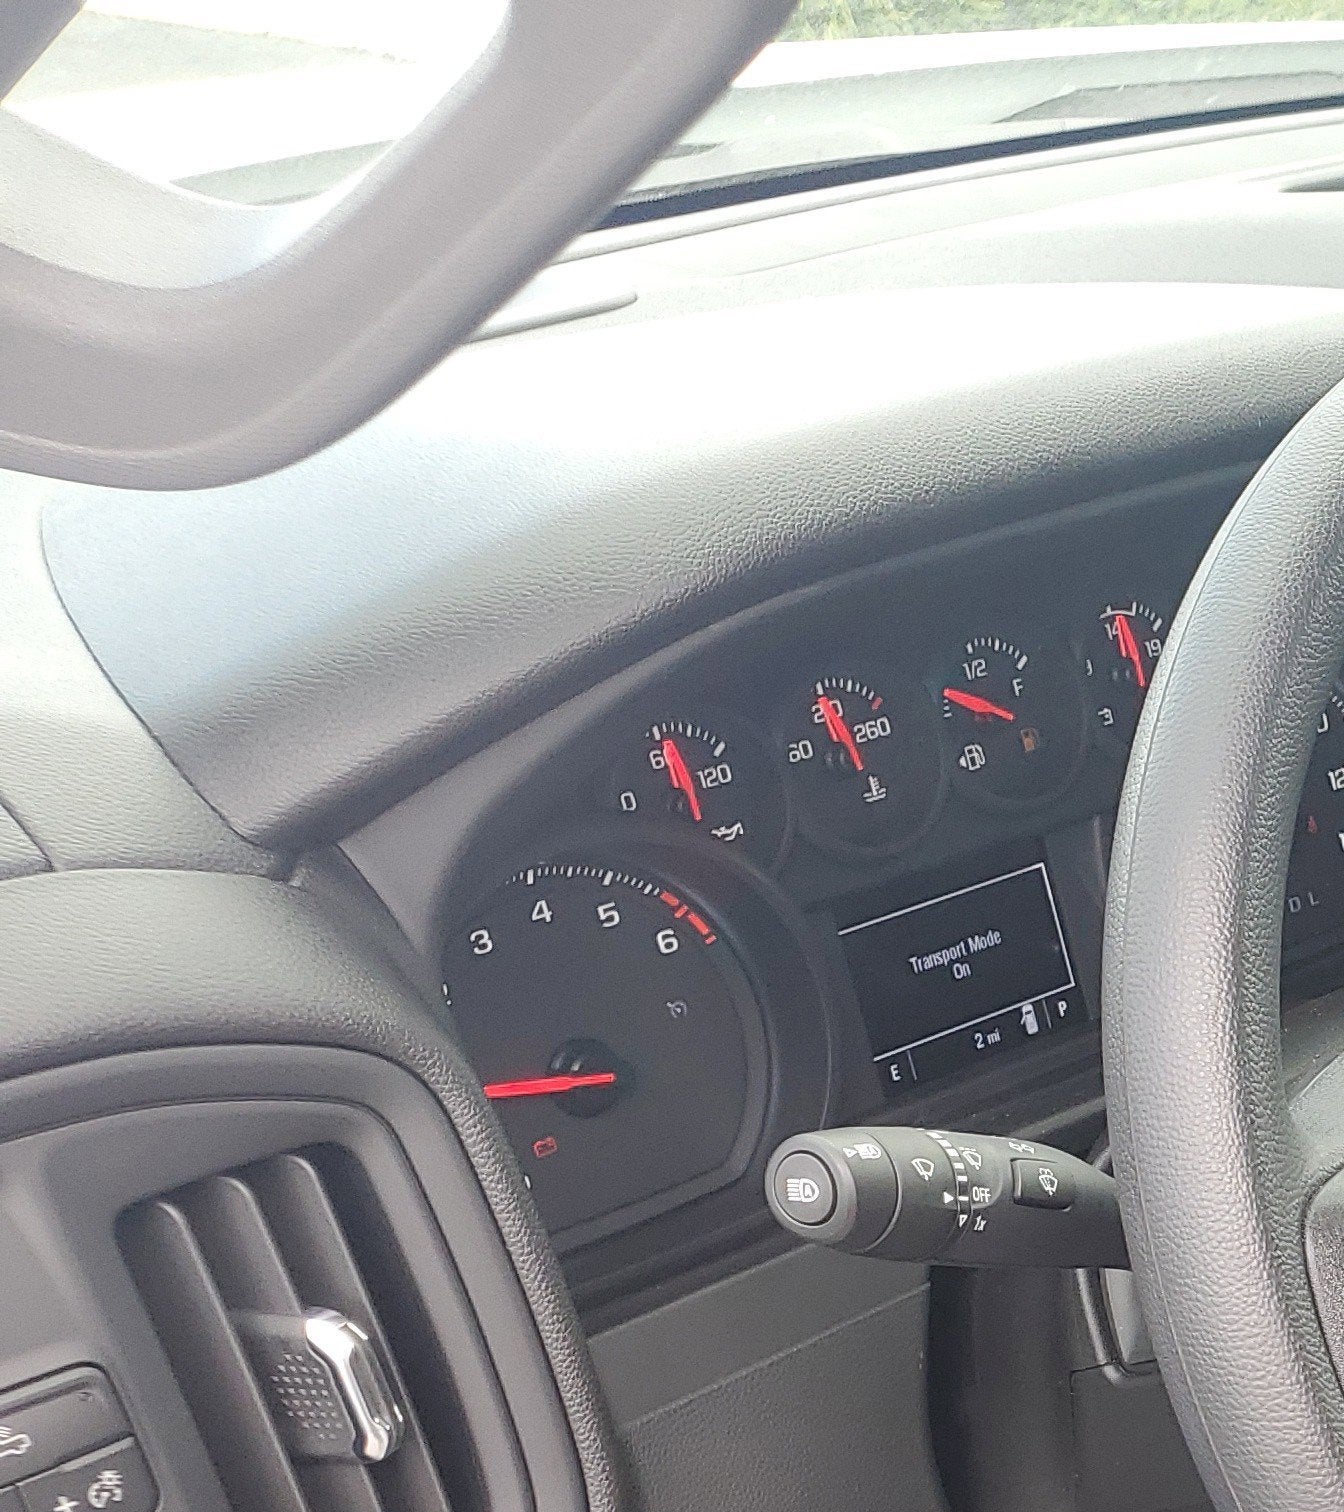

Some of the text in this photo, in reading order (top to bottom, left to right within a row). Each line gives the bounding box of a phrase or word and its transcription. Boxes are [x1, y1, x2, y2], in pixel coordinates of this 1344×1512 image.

[1144, 638, 1161, 658] 19
[962, 658, 988, 680] 1/2
[1012, 678, 1024, 697] F
[854, 716, 891, 743] 260
[696, 763, 732, 789] 120
[620, 791, 637, 811] 0
[531, 899, 553, 924] 4
[597, 901, 621, 928] 5
[469, 928, 493, 955] 3
[656, 928, 679, 954] 6
[908, 929, 1002, 975] Transport Mode
[953, 962, 972, 980] On
[1057, 1000, 1068, 1018] P
[974, 1028, 1001, 1050] 2 mi
[890, 1064, 902, 1082] E
[972, 1186, 992, 1203] OFF
[972, 1215, 987, 1232] 1x
